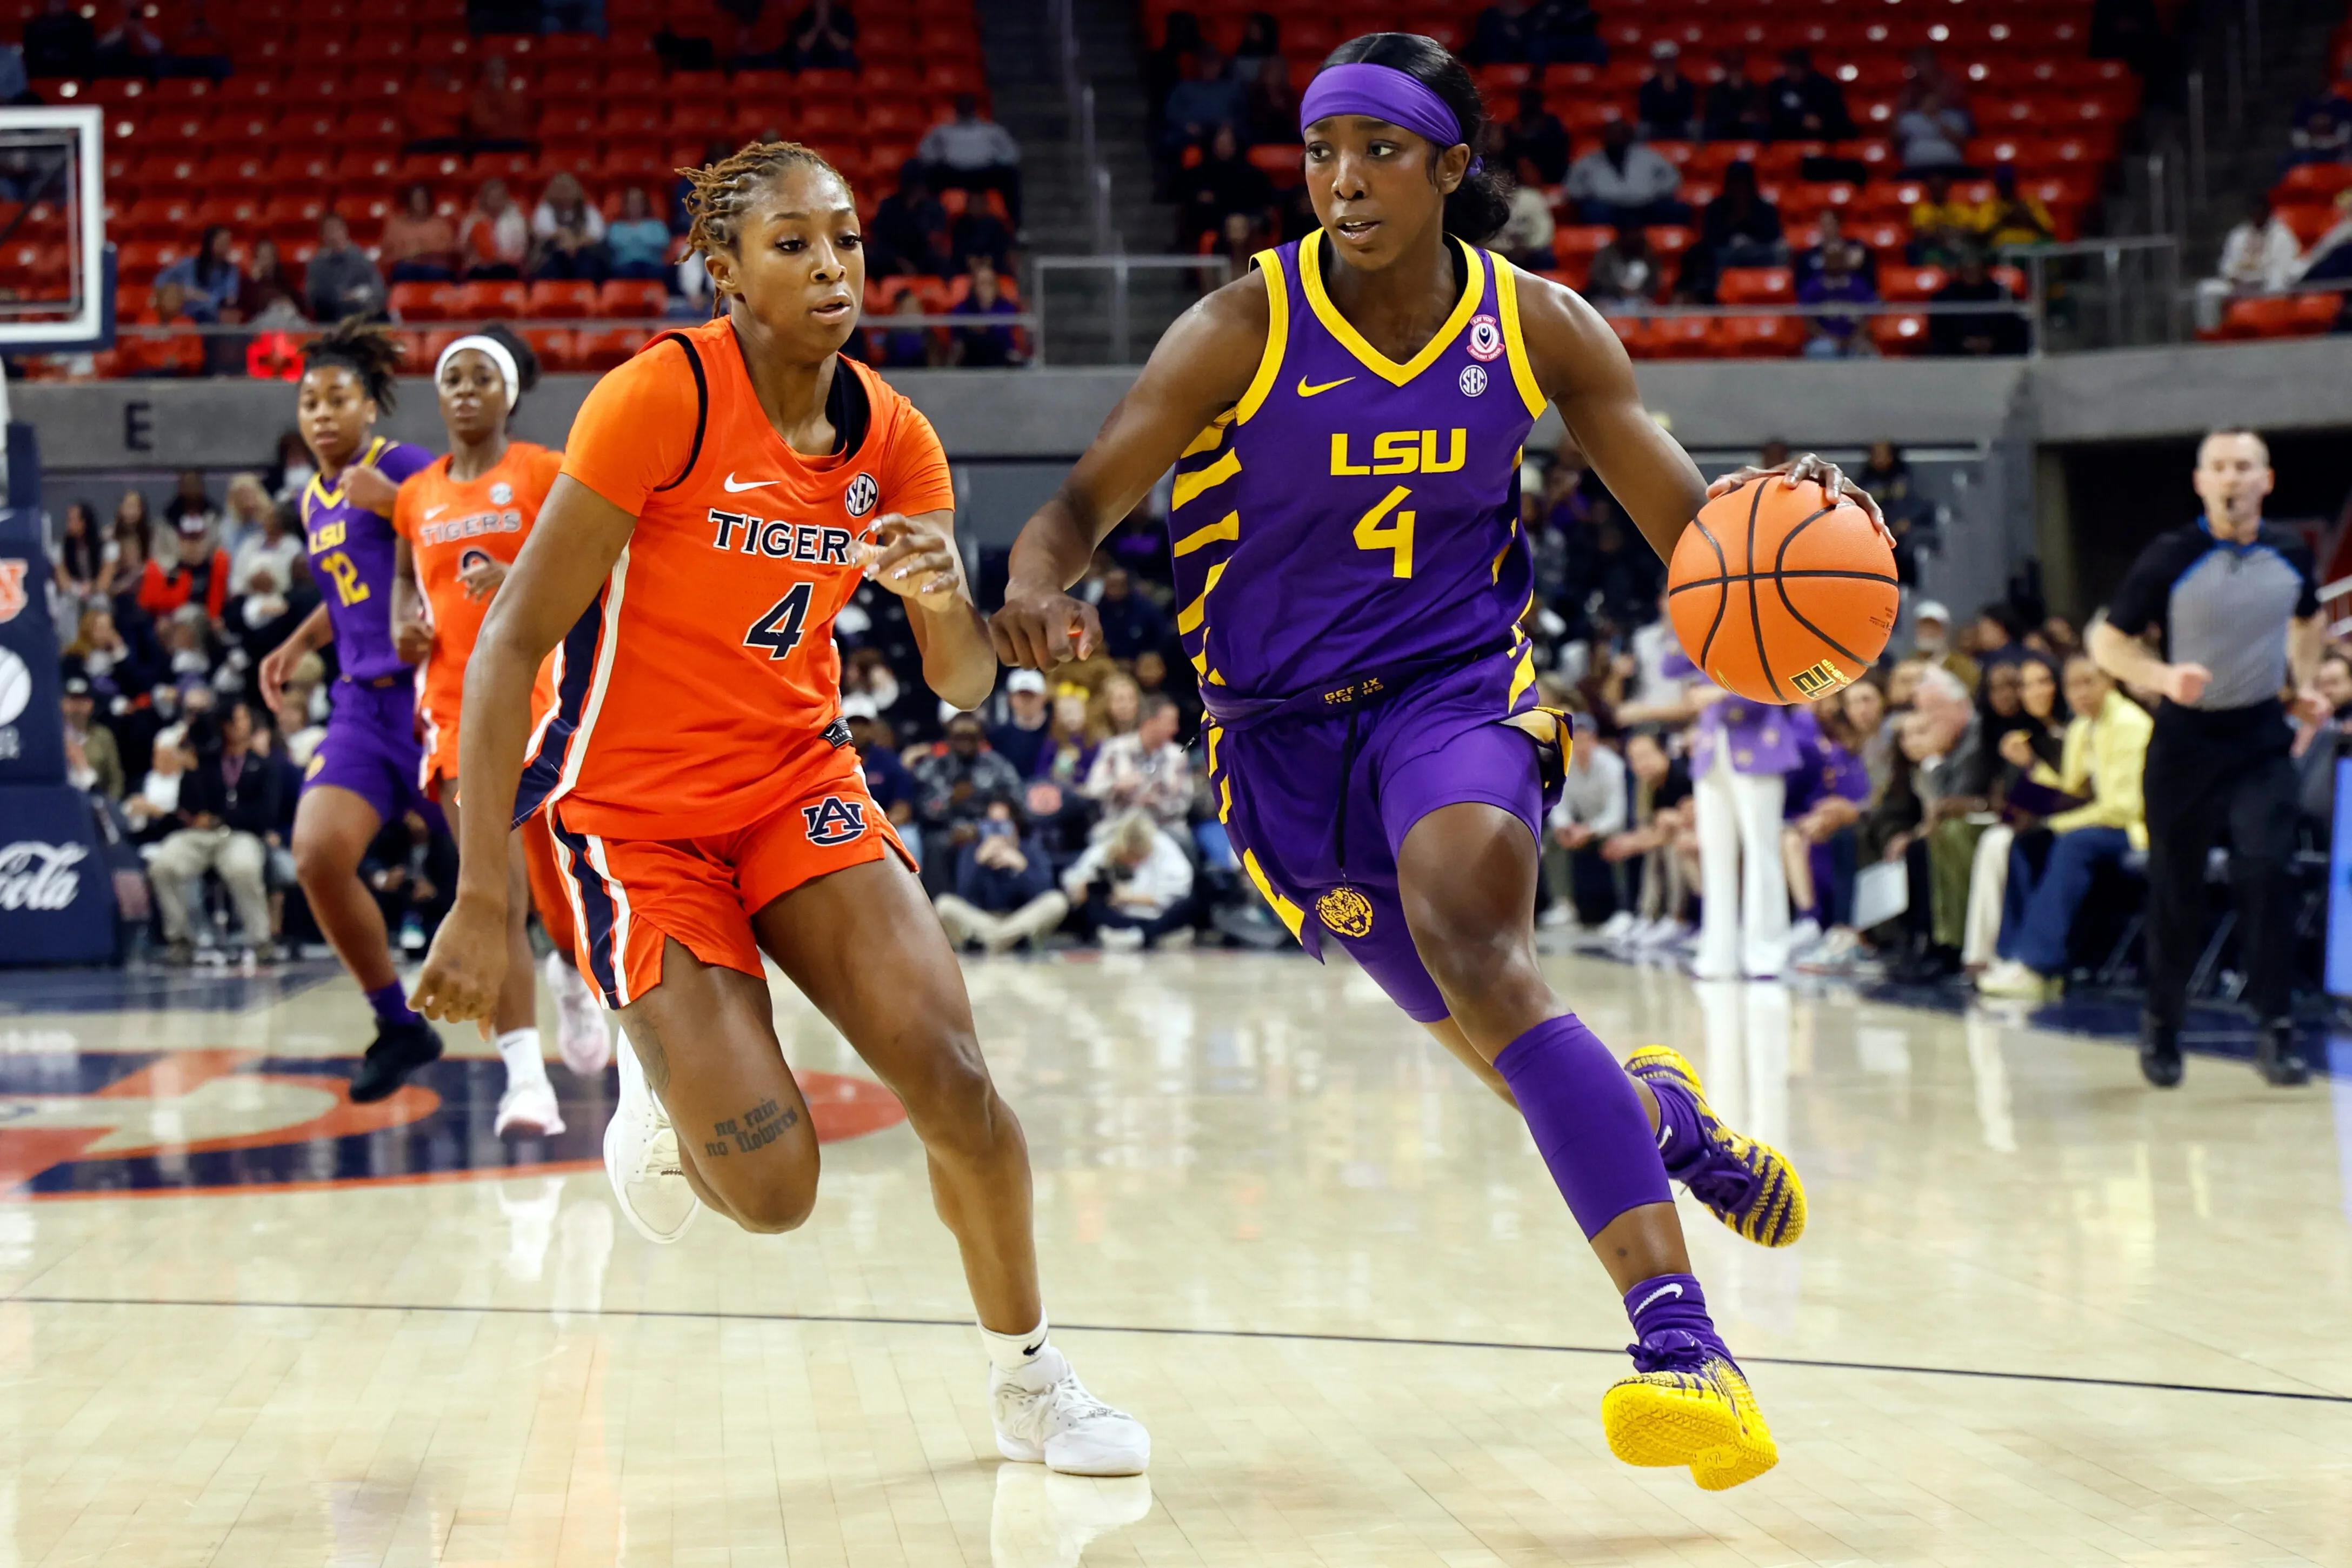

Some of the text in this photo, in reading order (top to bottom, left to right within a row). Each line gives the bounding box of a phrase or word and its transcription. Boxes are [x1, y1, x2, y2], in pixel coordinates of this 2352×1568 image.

[1462, 368, 1485, 395] SEC
[124, 401, 153, 452] E
[1330, 428, 1467, 476] LSU
[847, 476, 876, 515] SEC
[309, 519, 347, 555] LSU
[419, 509, 522, 548] TIGERS
[708, 508, 867, 565] TIGER
[1352, 485, 1416, 579] 4
[320, 551, 371, 608] 12
[742, 582, 815, 660] 4
[715, 1097, 779, 1137] no rain
[705, 1141, 728, 1157] no
